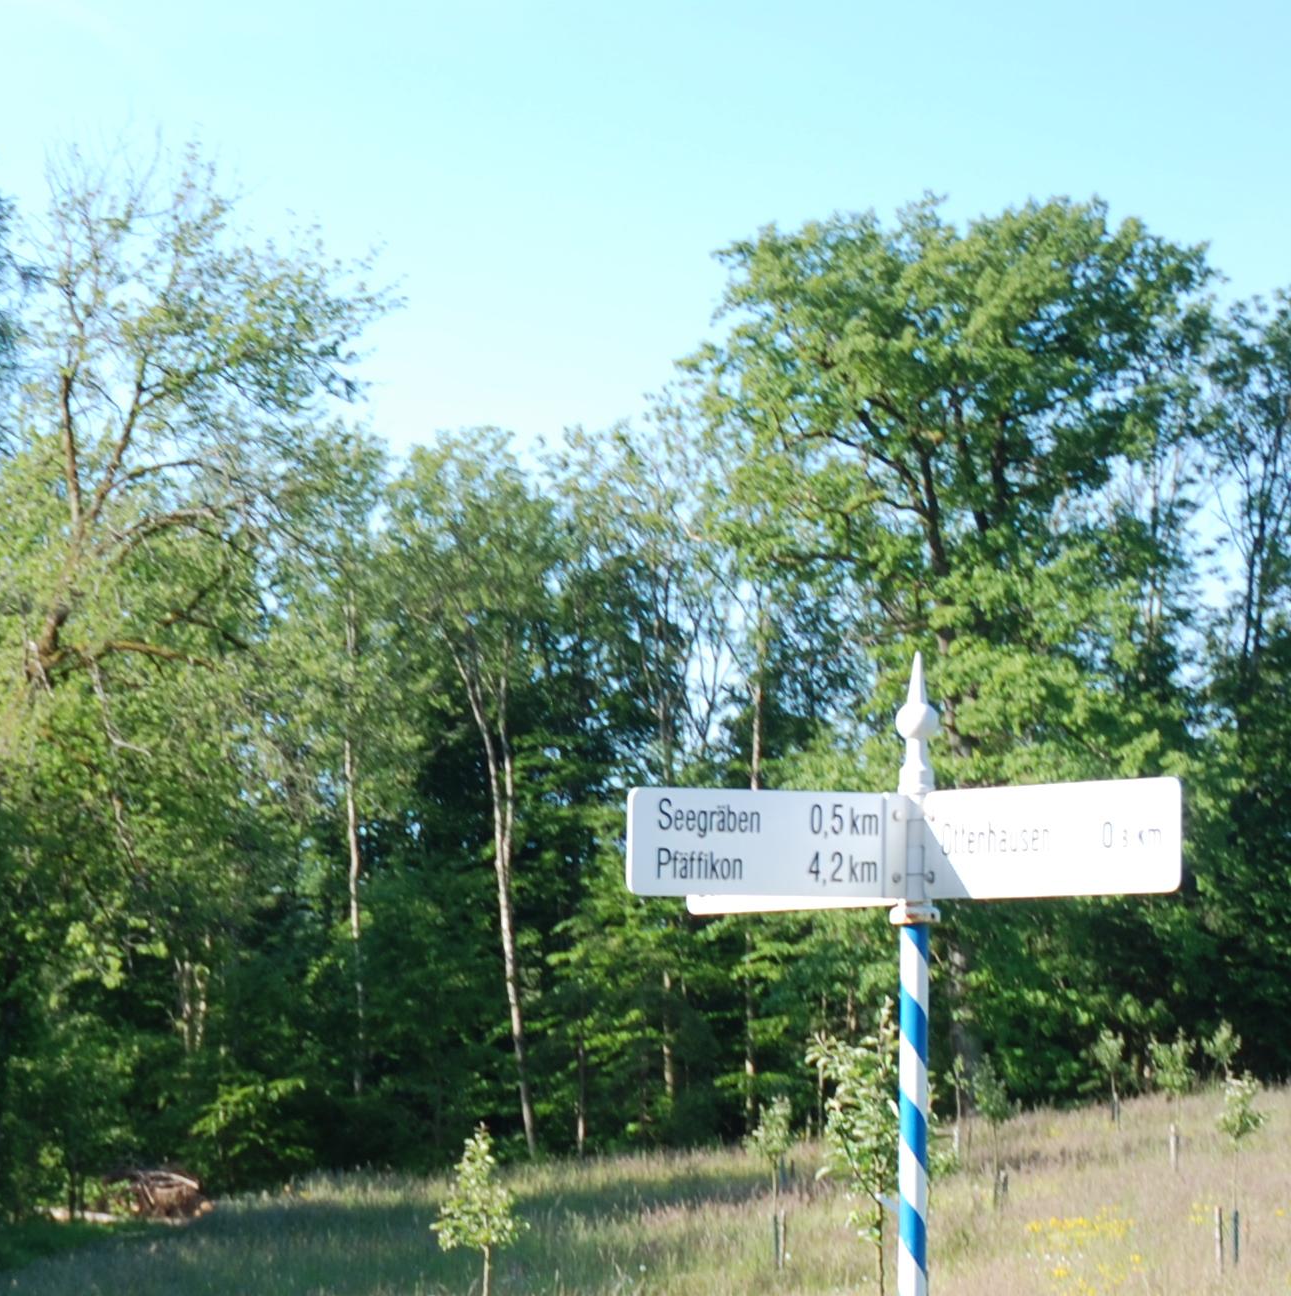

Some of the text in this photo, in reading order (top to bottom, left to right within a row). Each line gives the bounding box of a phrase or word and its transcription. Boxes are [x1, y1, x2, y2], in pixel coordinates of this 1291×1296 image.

[657, 797, 879, 838] Seegräben 0,5 km
[941, 821, 1051, 856] Ottenhausen
[656, 847, 878, 886] Pfäffikon 4,2 km
